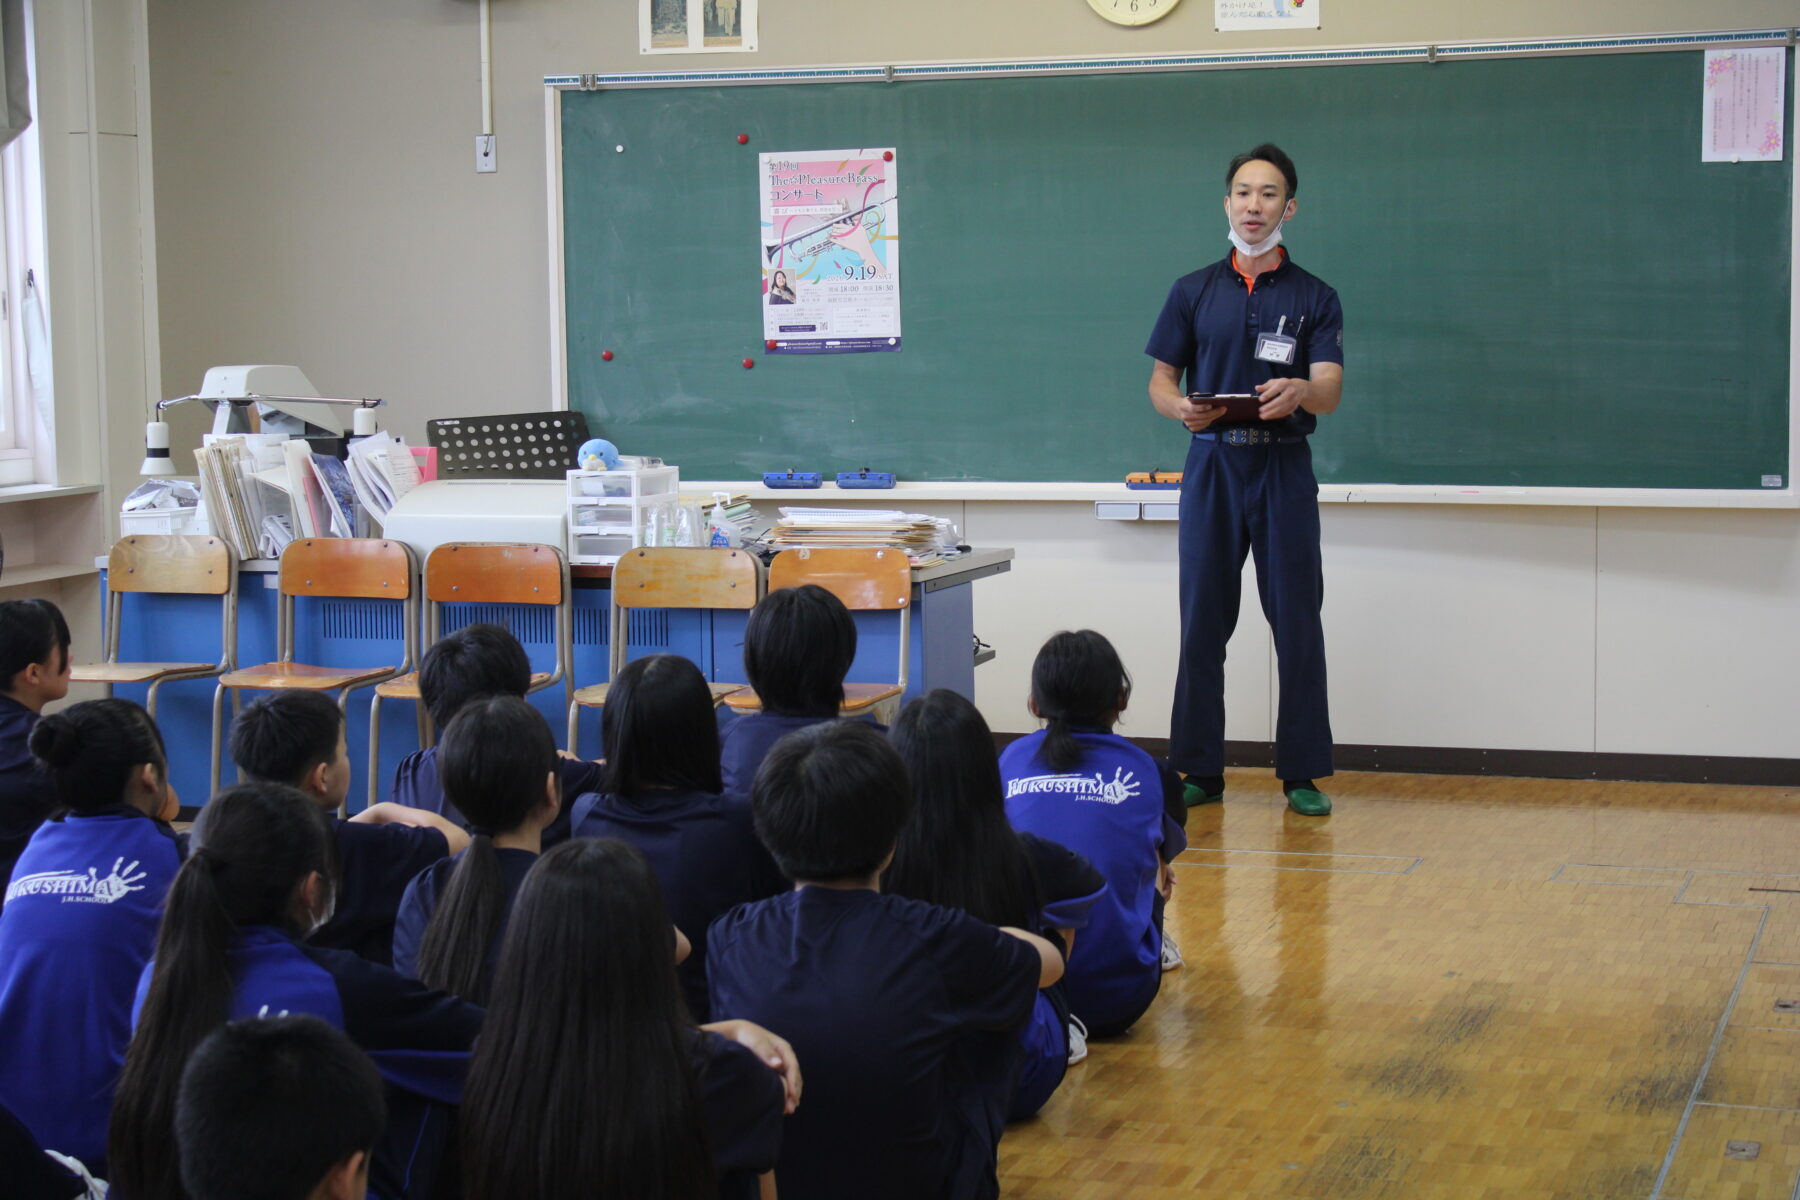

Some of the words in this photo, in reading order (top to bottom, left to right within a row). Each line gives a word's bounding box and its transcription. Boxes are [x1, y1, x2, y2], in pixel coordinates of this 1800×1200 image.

[1130, 0, 1139, 12] 6
[770, 188, 824, 201] コンサート
[844, 265, 877, 281] 9.19
[1005, 777, 1119, 799] FUKUSHIMA
